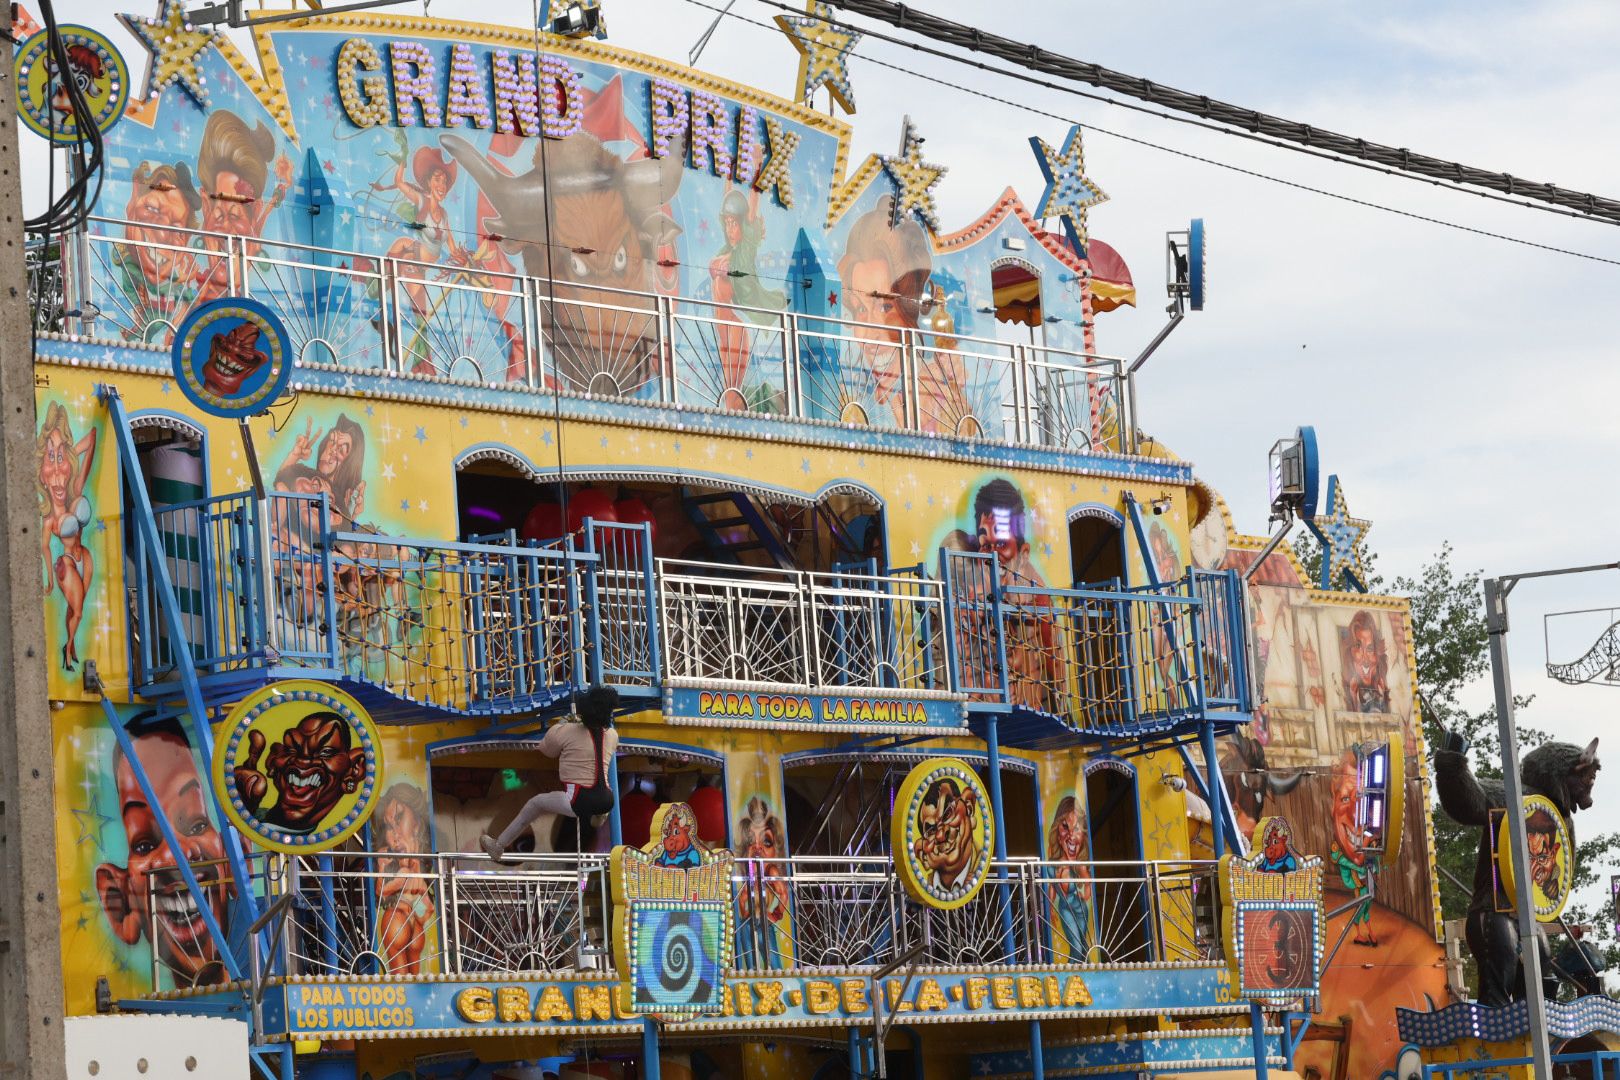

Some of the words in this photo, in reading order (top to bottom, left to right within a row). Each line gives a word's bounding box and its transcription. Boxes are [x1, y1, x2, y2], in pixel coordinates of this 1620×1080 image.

[337, 38, 584, 139] GRAND
[649, 77, 803, 210] PRIX
[699, 692, 753, 718] PARA
[756, 694, 813, 721] TODA
[821, 698, 848, 723] LA
[850, 699, 928, 725] FAMILIA
[624, 857, 686, 900] GRAND
[1232, 863, 1284, 900] GRAND
[301, 986, 345, 1006] PARA
[348, 985, 406, 1006] TODOS
[723, 980, 787, 1017] IX
[805, 979, 870, 1014] DE
[886, 977, 949, 1013] LA
[965, 975, 1093, 1011] FERIA
[296, 1008, 329, 1029] LOS
[332, 1007, 414, 1029] PUBLICOS
